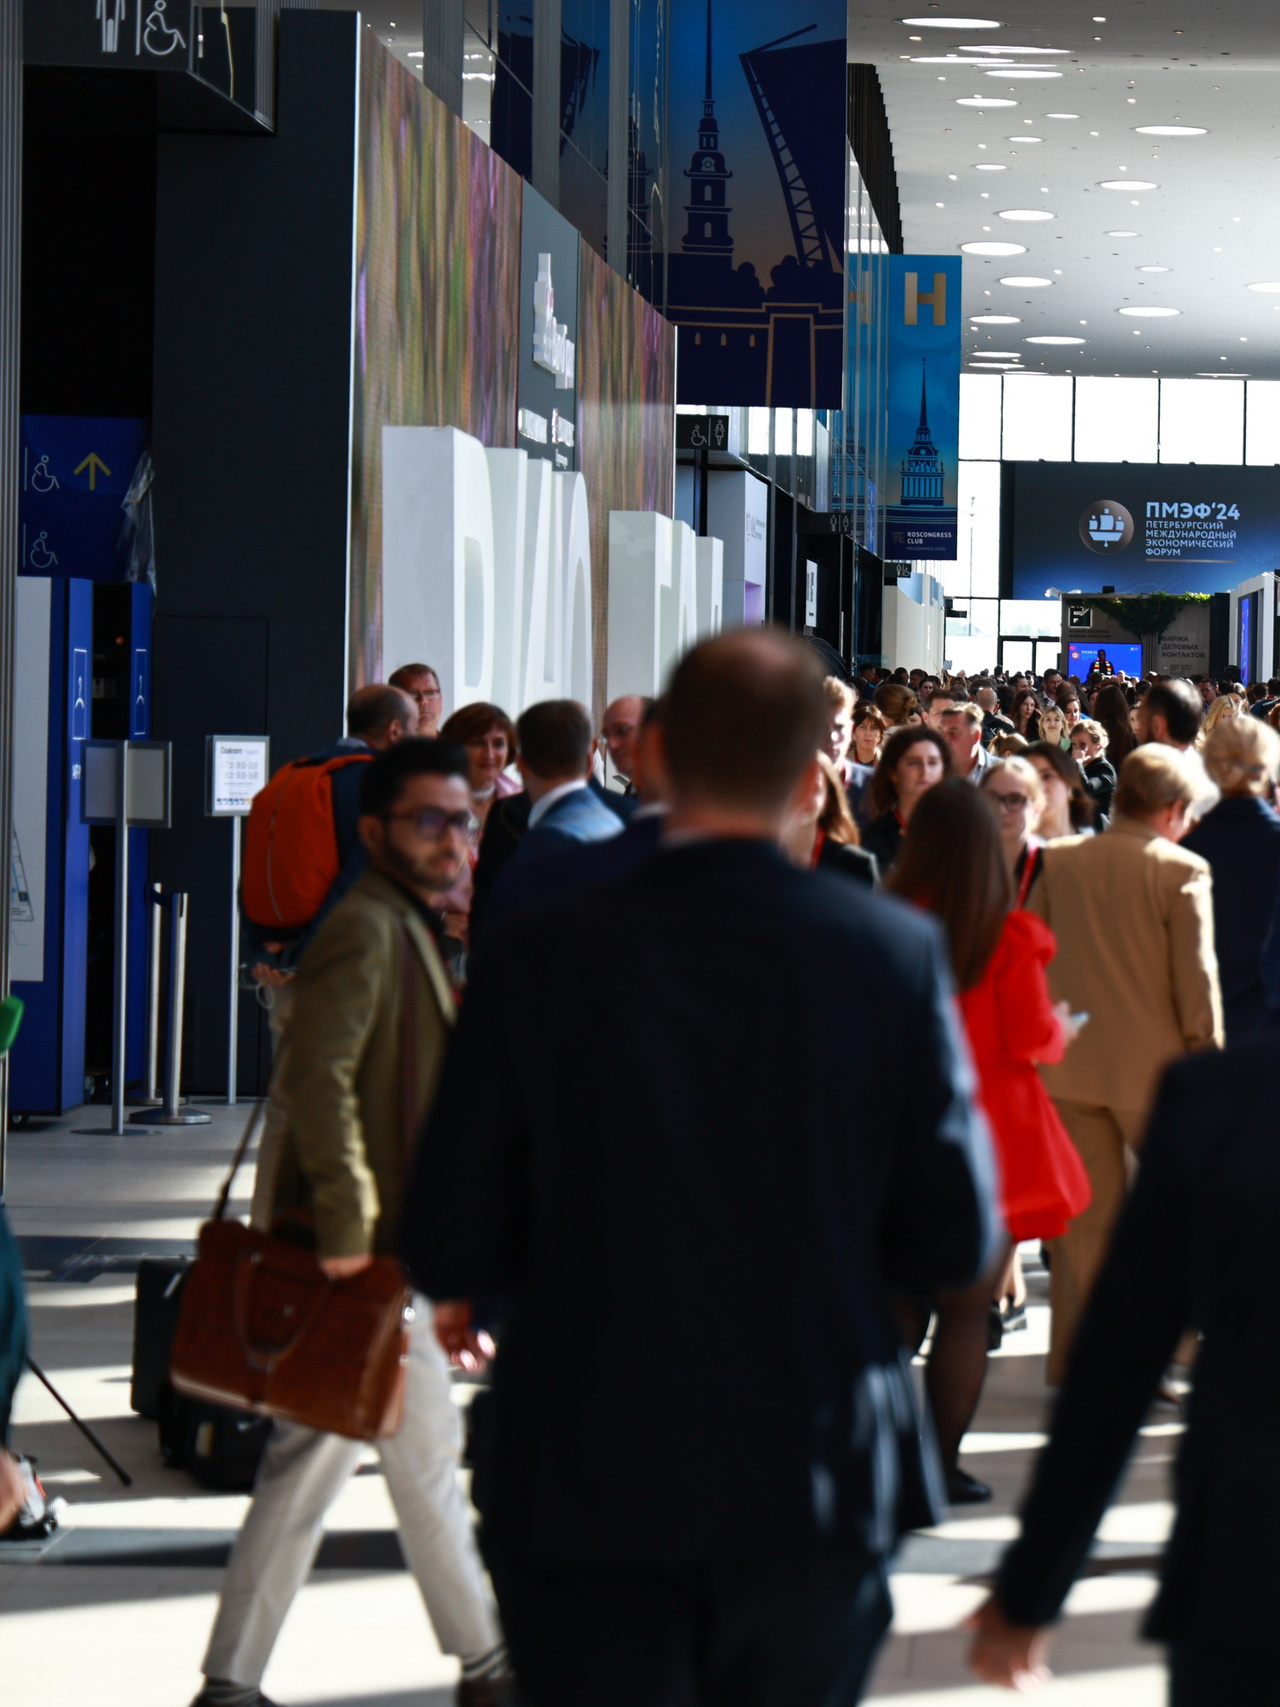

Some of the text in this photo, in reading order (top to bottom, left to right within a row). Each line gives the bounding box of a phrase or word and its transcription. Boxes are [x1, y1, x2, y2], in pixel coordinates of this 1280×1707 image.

[1145, 520, 1224, 530] ПЕТЕРБУРГСКИЙ
[1145, 529, 1237, 540] МЕЖДУНАРОДНЫЙ
[1145, 538, 1234, 548] ЭКОНОМИЧЕСКИЙ
[1145, 548, 1181, 557] ФОРУМ
